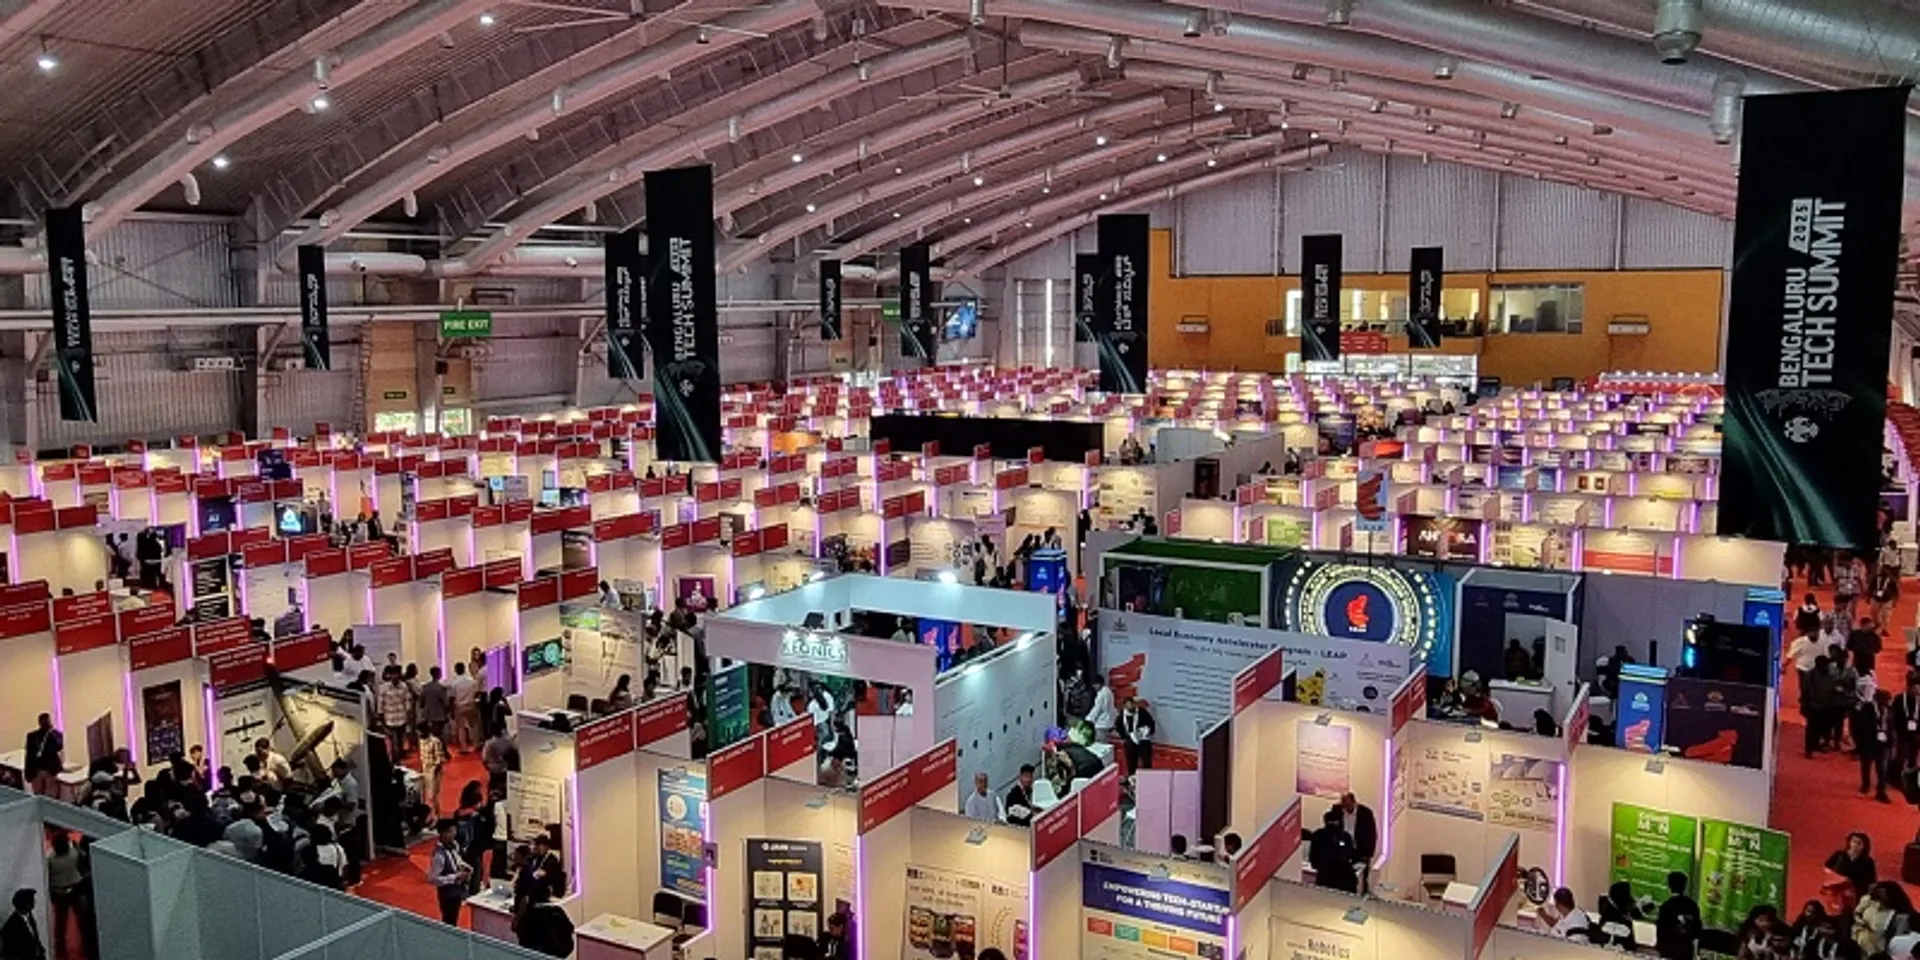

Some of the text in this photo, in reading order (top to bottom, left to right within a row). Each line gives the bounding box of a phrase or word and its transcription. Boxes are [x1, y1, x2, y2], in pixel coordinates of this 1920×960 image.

[1793, 206, 1808, 243] 2025
[1801, 198, 1846, 388] TECH SUMMIT
[444, 319, 488, 330] FIRE EXIT
[681, 314, 696, 360] TECH
[1779, 268, 1807, 388] BENGALURU
[1150, 627, 1172, 637] Local
[1174, 630, 1213, 644] Economy
[1320, 650, 1347, 659] LEAP
[1103, 881, 1162, 903] EMPOWERING
[1116, 894, 1222, 925] FOR A THRIVING FUTURE
[1307, 938, 1350, 959] Robotics
